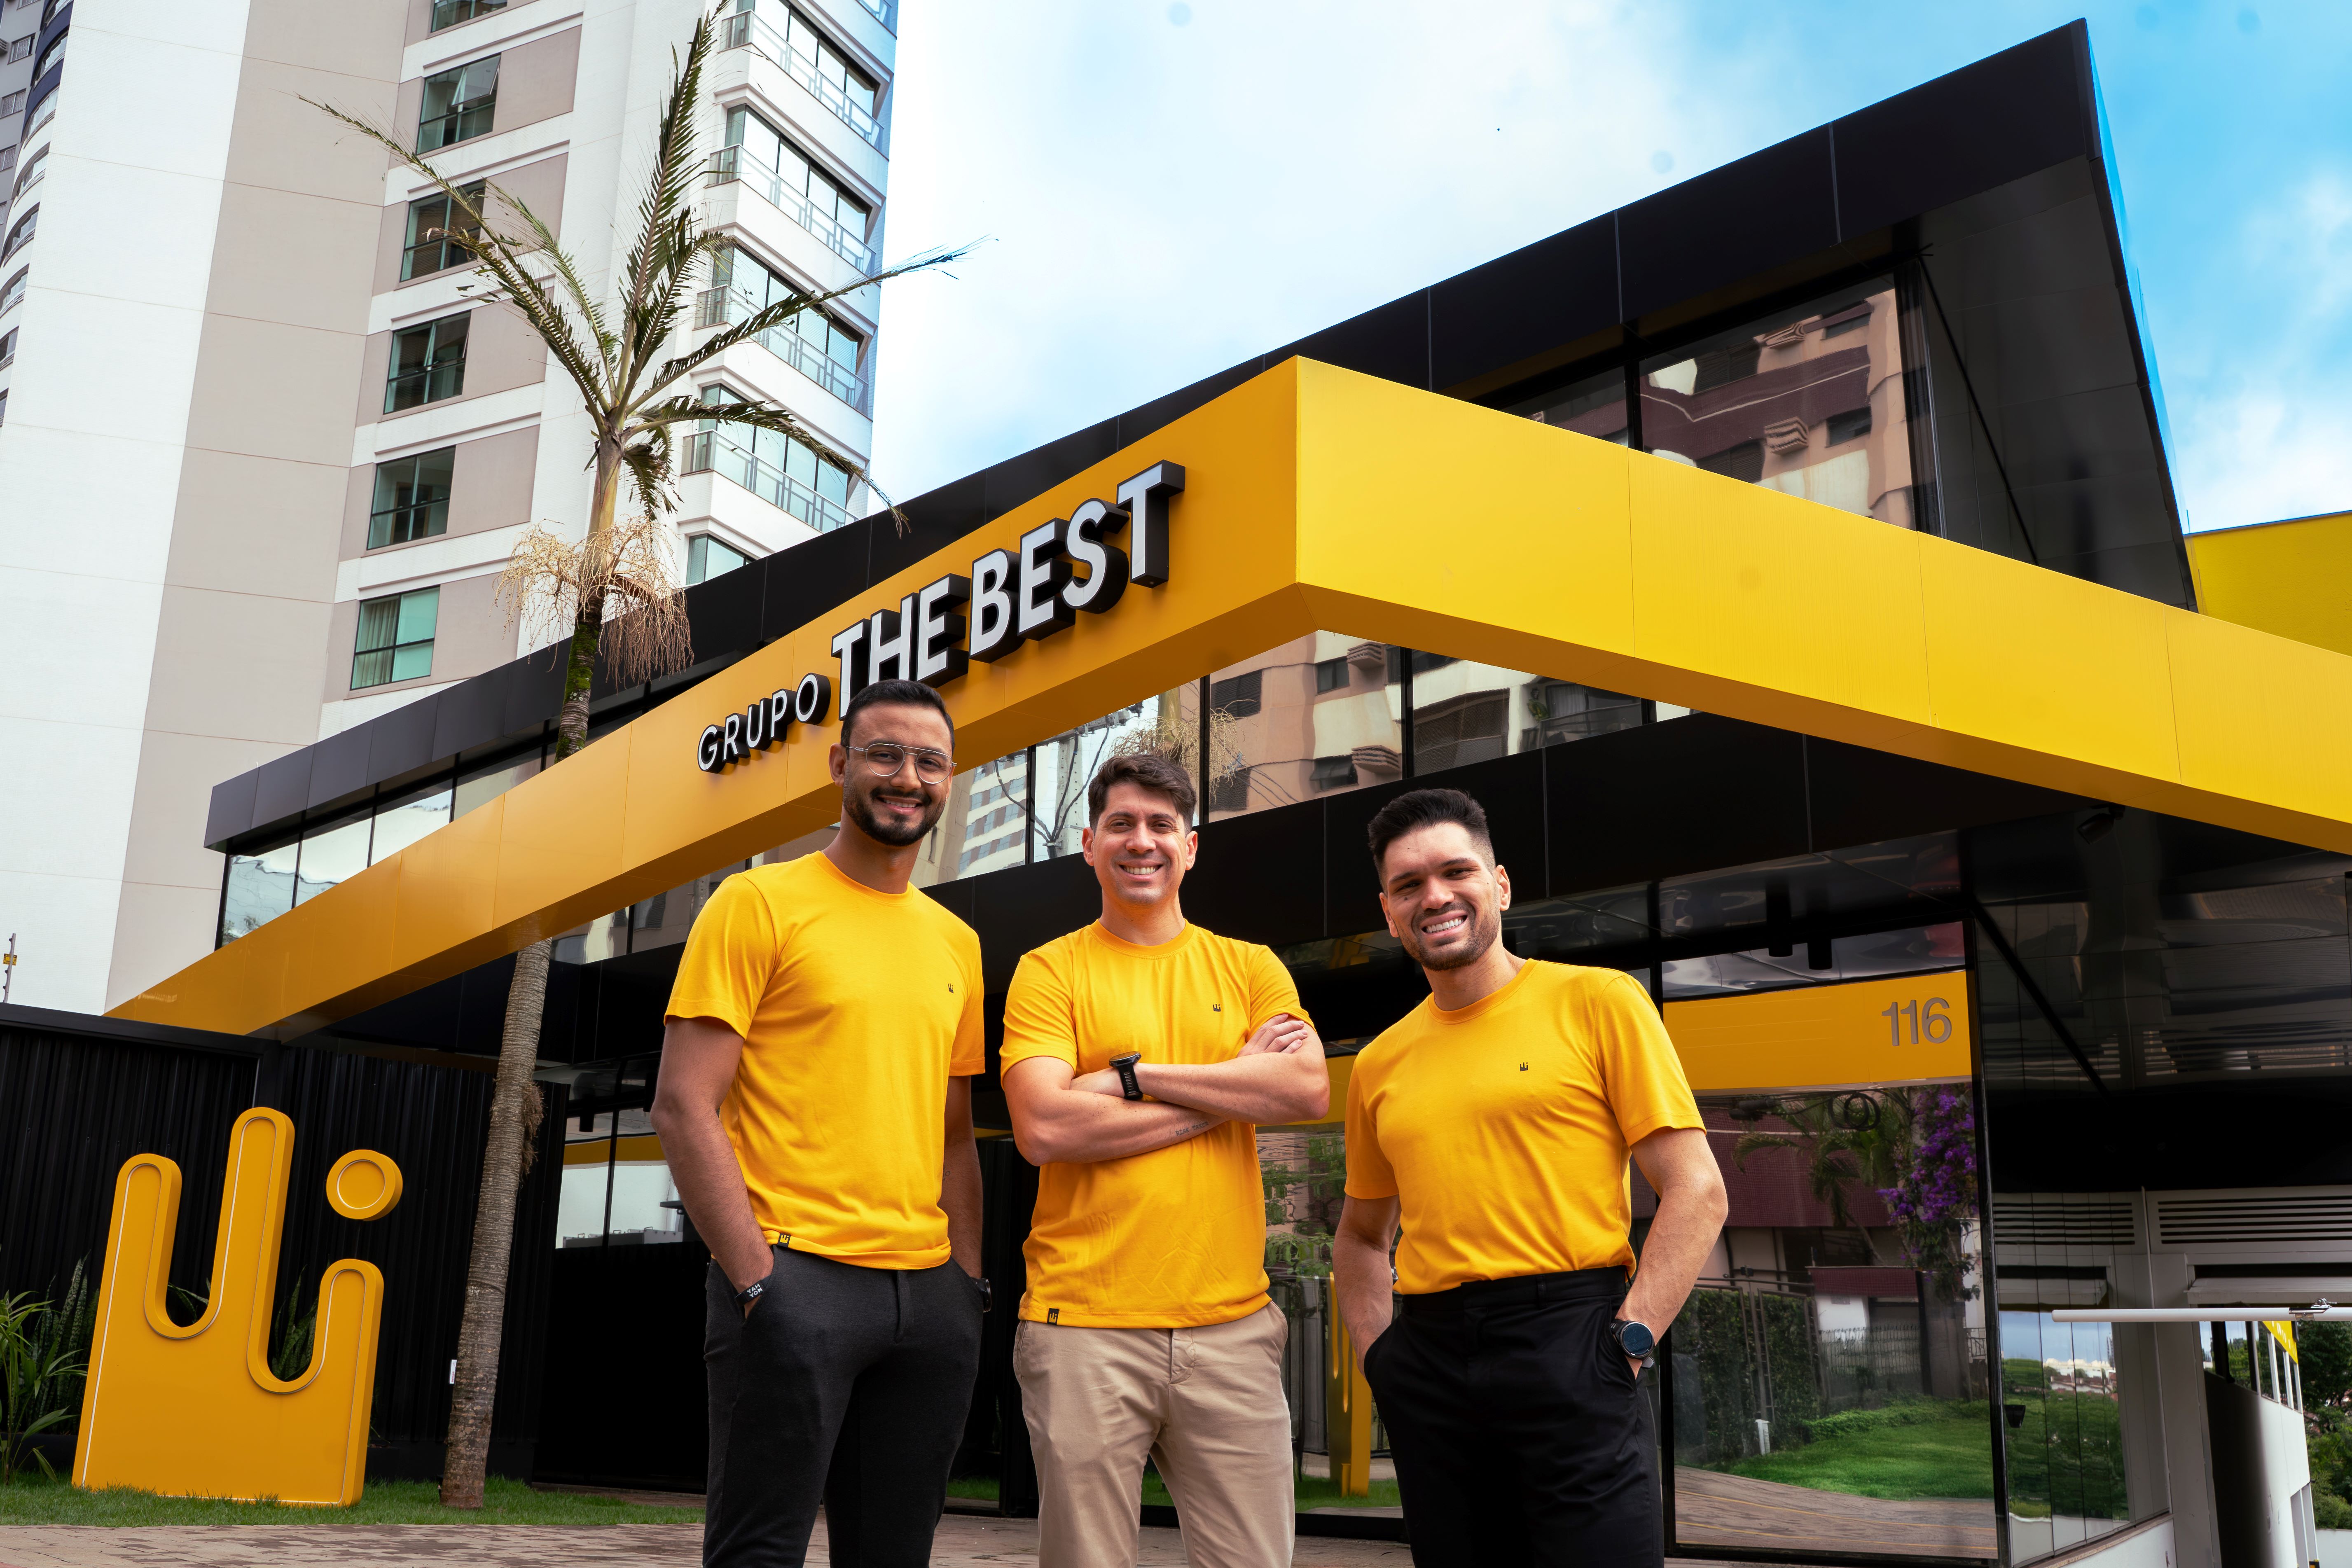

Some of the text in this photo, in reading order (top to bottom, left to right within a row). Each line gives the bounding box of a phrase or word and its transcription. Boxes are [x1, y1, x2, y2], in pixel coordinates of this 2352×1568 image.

[697, 459, 1185, 773] GRUPO THE BEST
[1881, 997, 1952, 1047] 116
[1175, 1127, 1190, 1136] RISK
[746, 1283, 760, 1293] YAH
[749, 1287, 763, 1297] YOM
